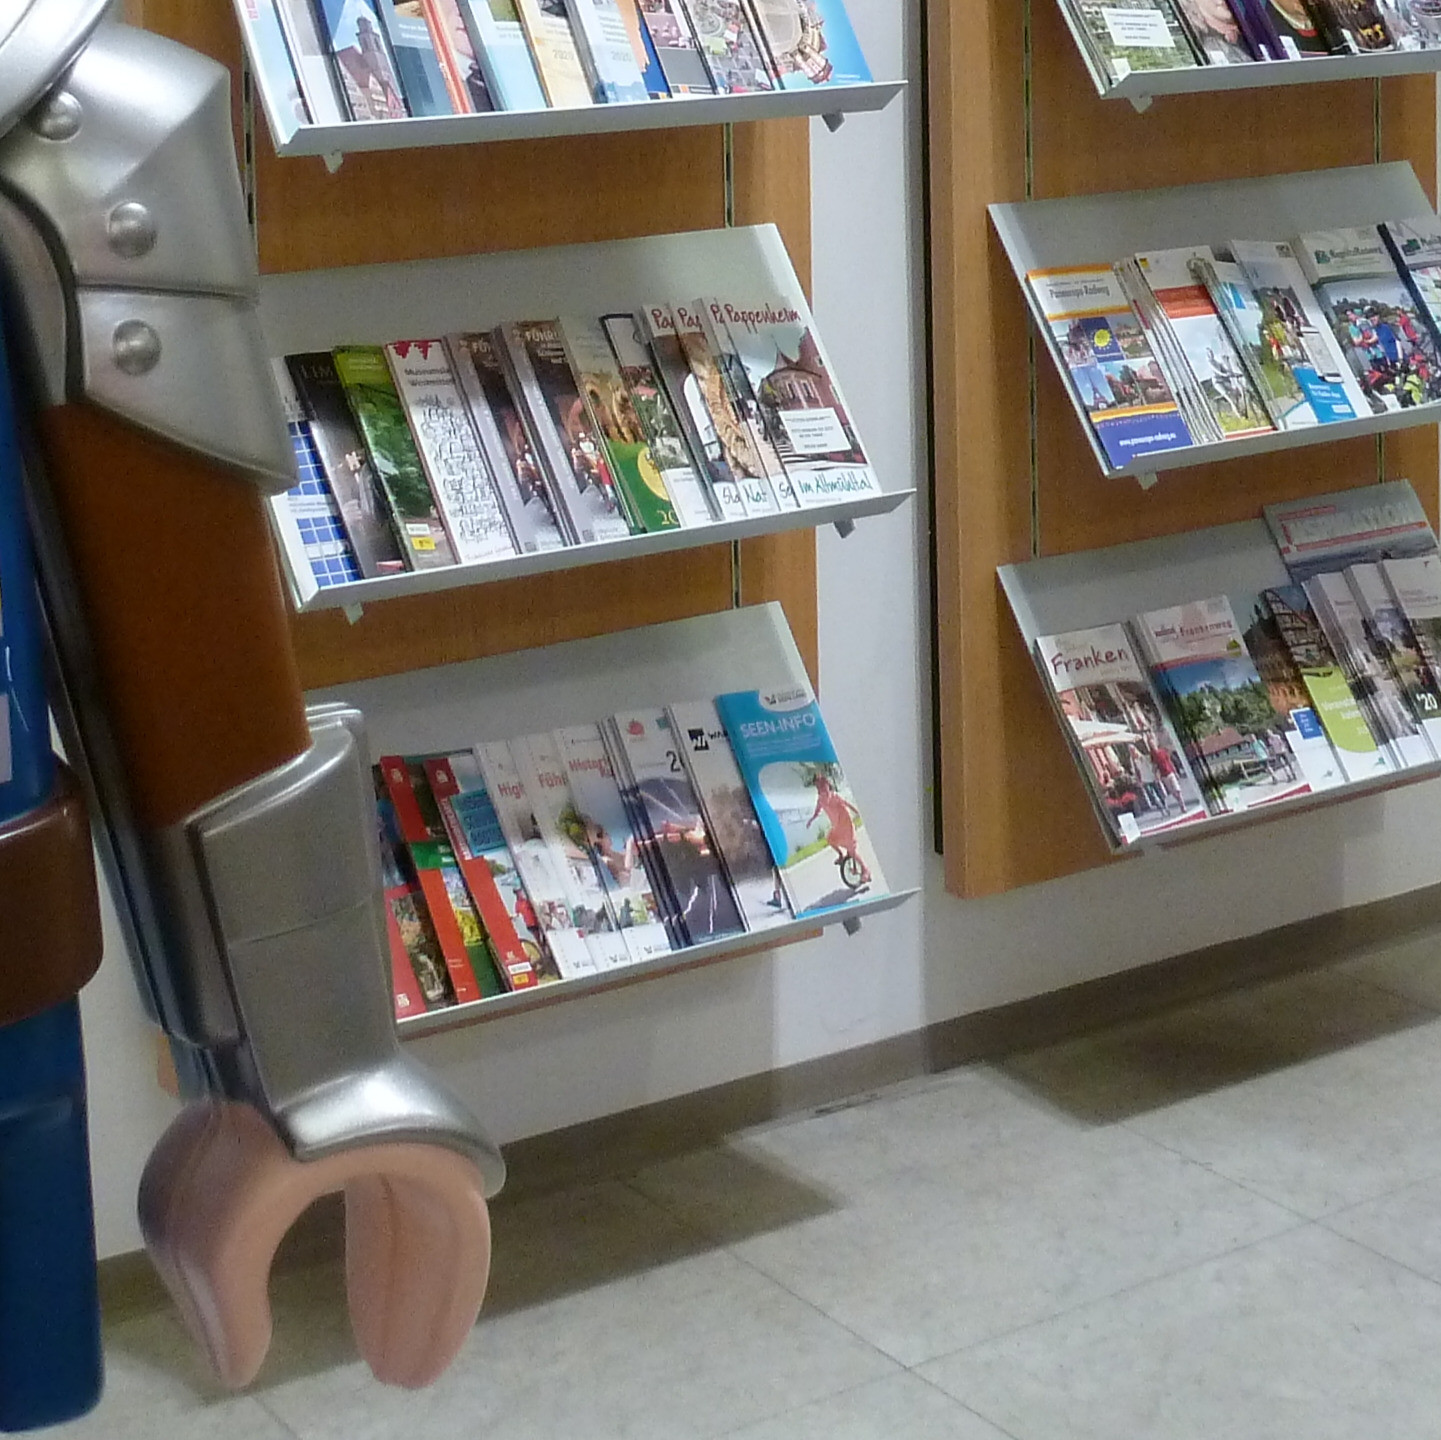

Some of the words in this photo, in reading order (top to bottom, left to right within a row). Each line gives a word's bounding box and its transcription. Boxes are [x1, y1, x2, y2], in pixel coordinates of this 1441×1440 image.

[723, 302, 802, 335] Pappenheim
[797, 478, 812, 495] Im
[1050, 645, 1129, 676] Franken
[739, 712, 817, 740] SEEN-INFO
